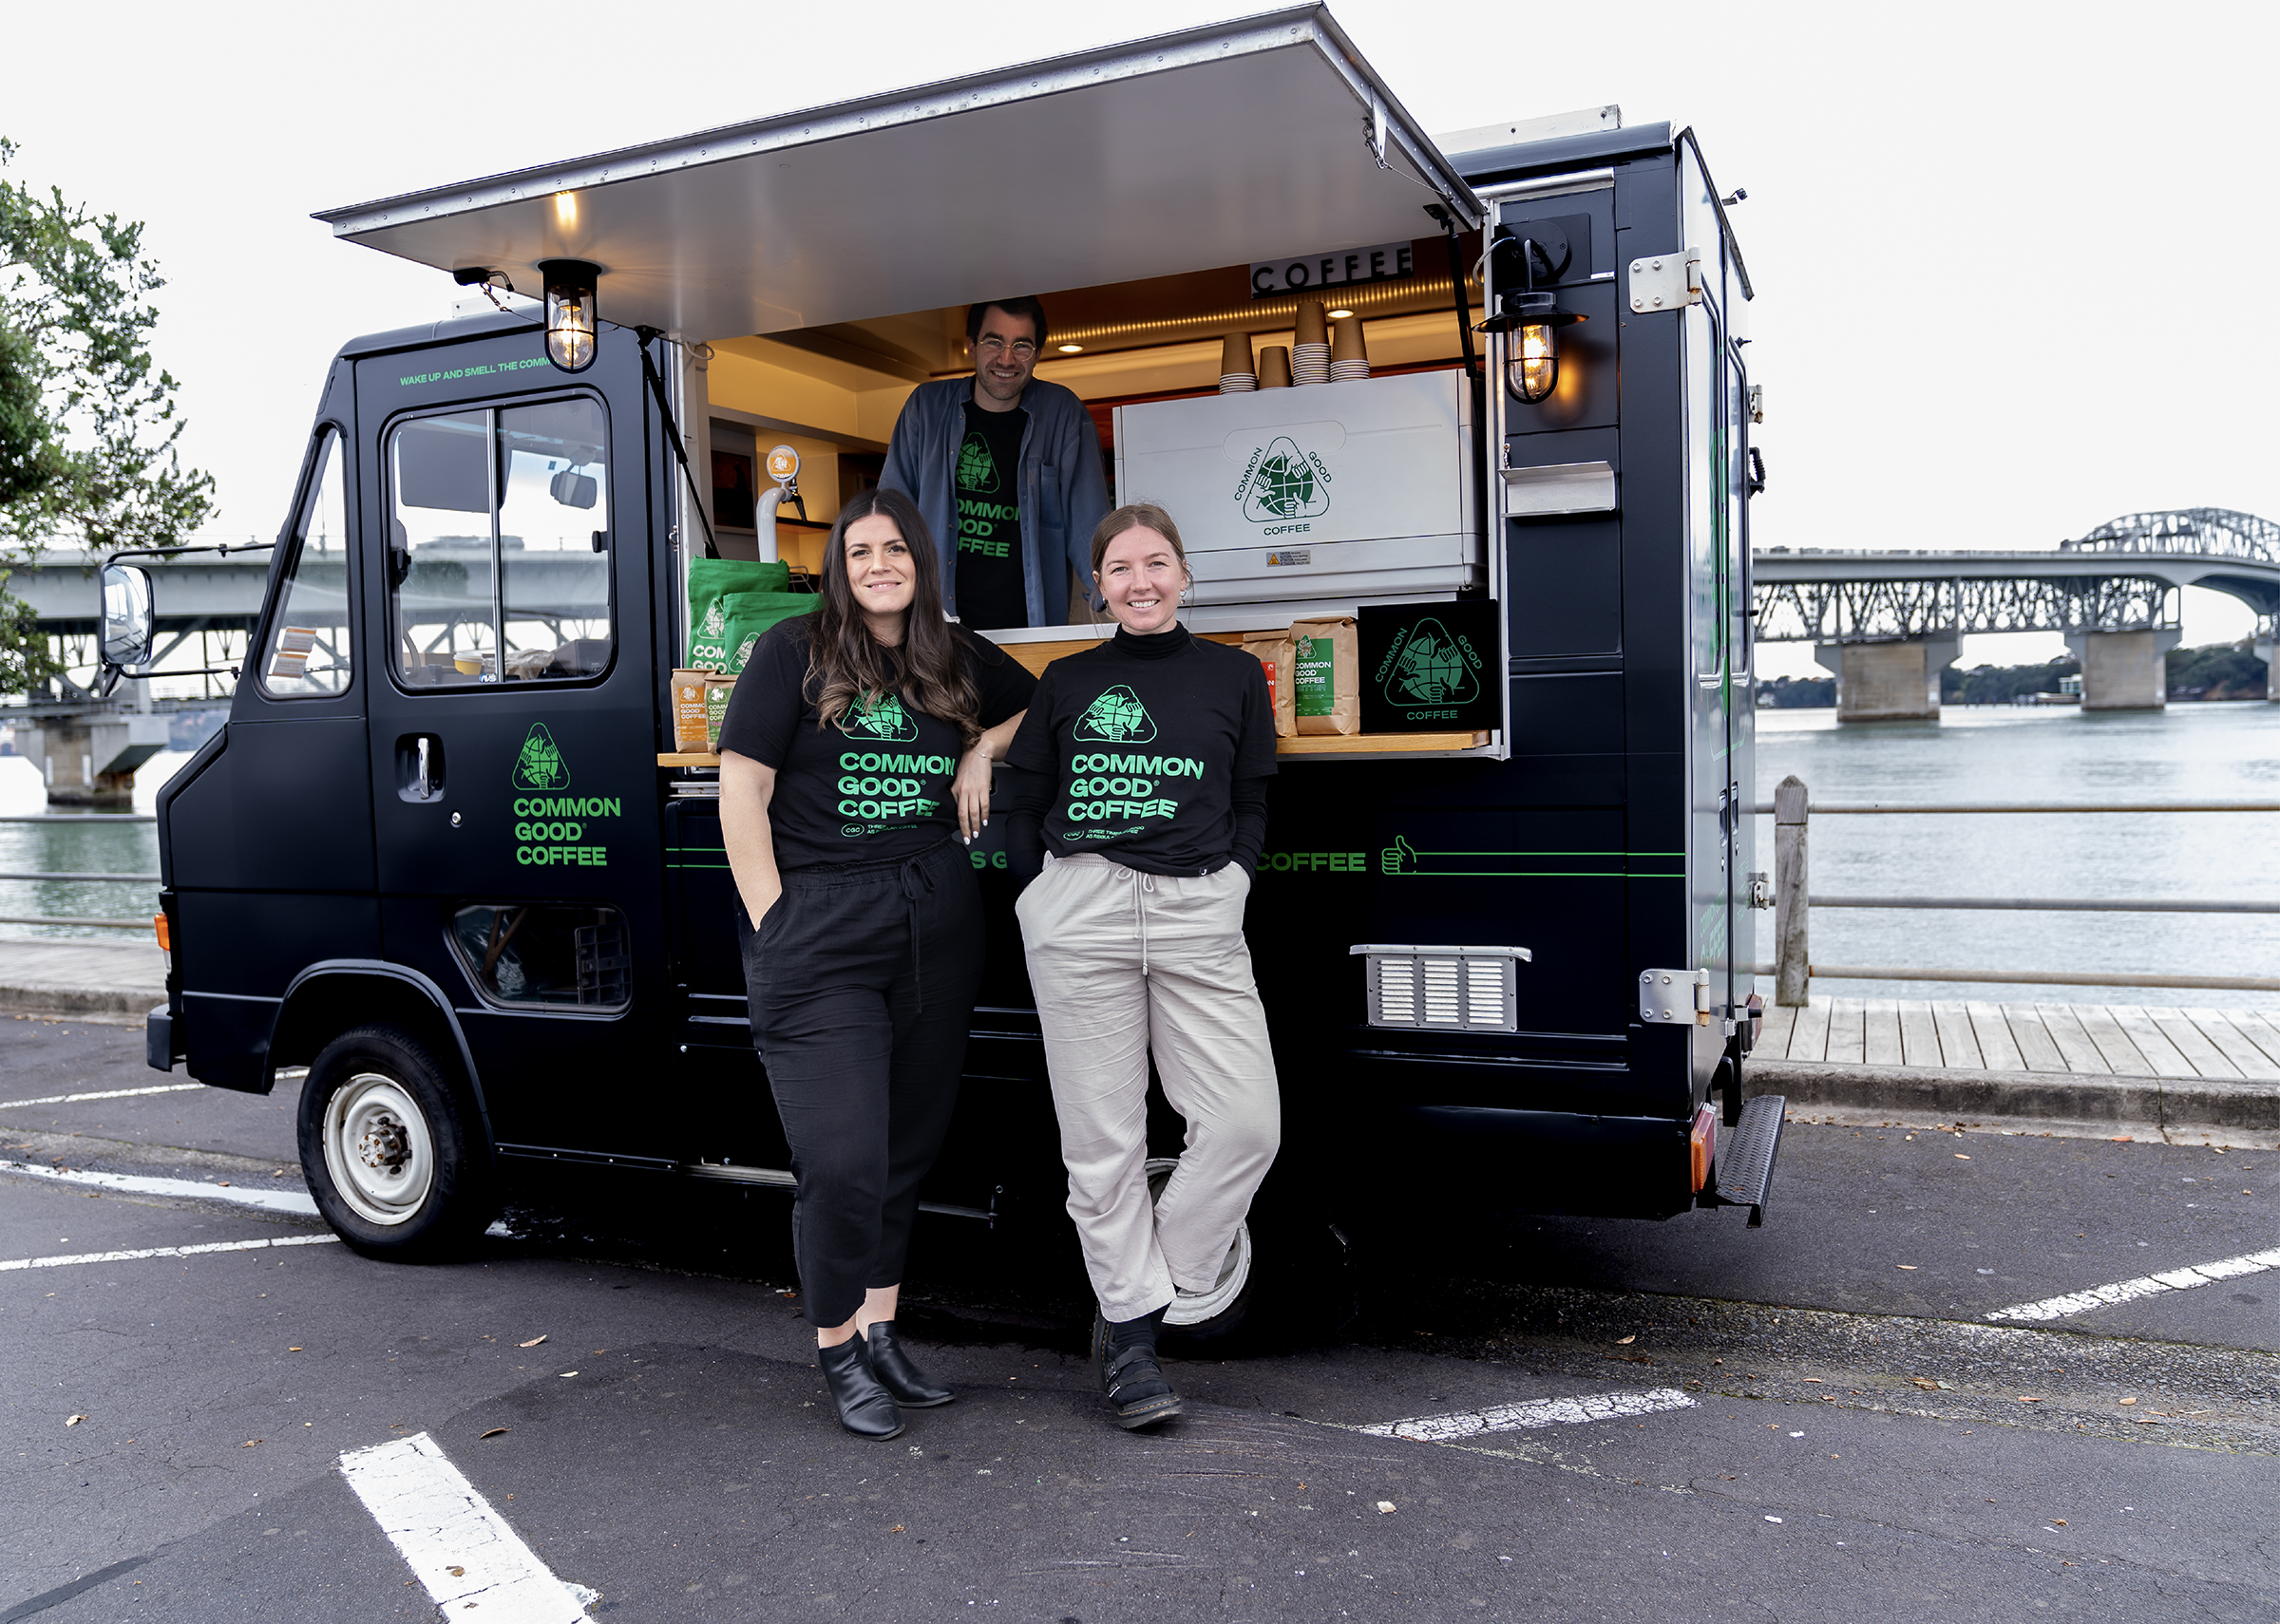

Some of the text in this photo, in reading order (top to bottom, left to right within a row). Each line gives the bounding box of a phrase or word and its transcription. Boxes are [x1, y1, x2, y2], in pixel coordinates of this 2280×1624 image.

[1251, 247, 1412, 293] COFFEE
[400, 357, 559, 387] WAKE UP AND SMELL THE COMM
[1234, 446, 1263, 501] COMMON
[1308, 451, 1332, 483] GOOD
[956, 498, 1020, 520] OMMO
[1263, 523, 1311, 536] COFFEE
[958, 537, 1011, 557] FFEE
[693, 644, 726, 659] COM
[1375, 627, 1408, 683] COMMON
[1457, 634, 1483, 670] GOOD
[692, 659, 728, 674] GOO
[1296, 684, 1327, 692] ETTER
[1406, 709, 1458, 721] COFFEE
[839, 752, 956, 777] COMMON
[1071, 753, 1205, 781] COMMON
[513, 797, 621, 818] COMMON
[837, 798, 940, 820] COFFEE
[1067, 799, 1179, 821] COFFEE
[516, 845, 608, 866] COFFEE
[1255, 852, 1367, 872] COFFEE
